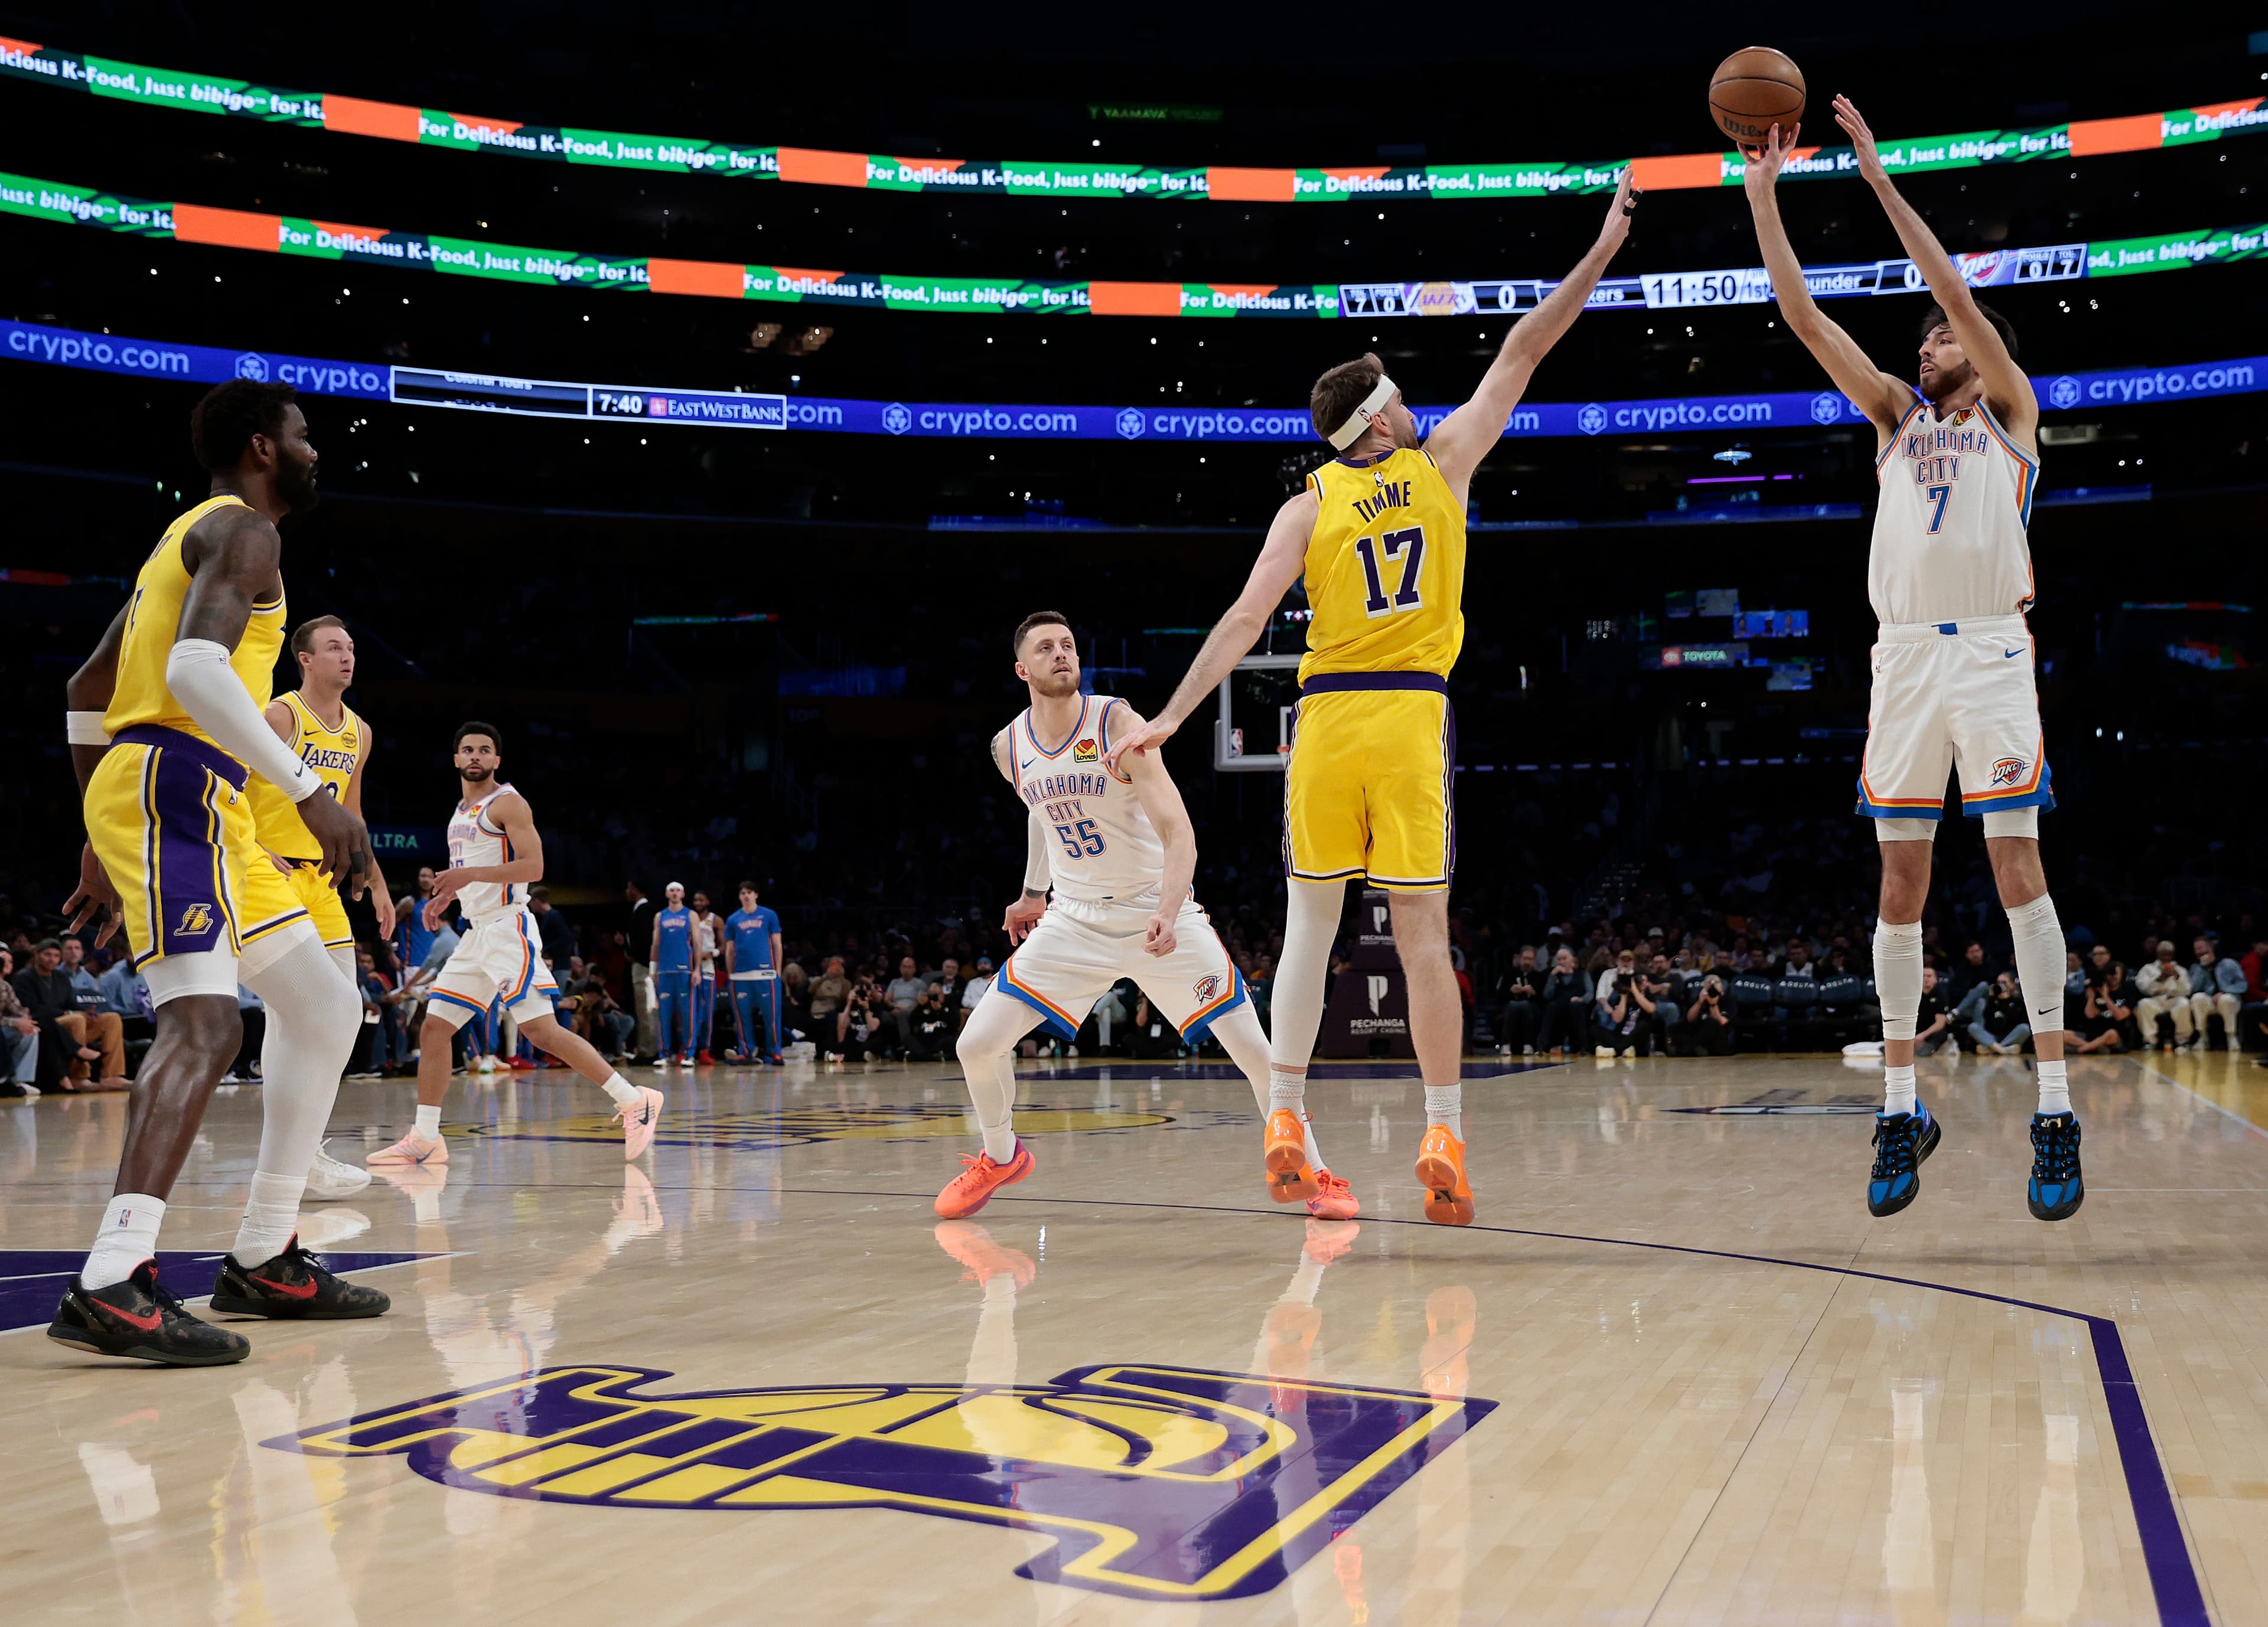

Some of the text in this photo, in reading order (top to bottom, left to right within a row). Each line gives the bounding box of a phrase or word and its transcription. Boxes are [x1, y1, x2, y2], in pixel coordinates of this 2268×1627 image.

[0, 45, 58, 75] icious
[145, 77, 185, 99] Just
[270, 95, 301, 115] for
[1723, 115, 1785, 137] Wils
[2160, 107, 2268, 139] For Deliciou
[418, 116, 449, 137] For
[454, 121, 537, 151] Delicious
[617, 142, 653, 161] Just
[729, 151, 757, 169] for
[1779, 154, 1834, 174] icious
[1837, 149, 1907, 170] K-od,
[1909, 148, 1944, 165] Just
[2020, 135, 2048, 152] for
[865, 162, 895, 181] For
[898, 165, 979, 185] Delicious
[1054, 172, 1089, 188] Just
[1161, 174, 1188, 190] for
[1292, 176, 1322, 194] For
[1325, 174, 1404, 193] Delicious
[1477, 173, 1512, 190] Just
[1584, 169, 1611, 185] for
[119, 204, 149, 224] for
[278, 224, 311, 245] For
[316, 230, 403, 257] Delicious
[484, 252, 520, 271] Just
[598, 263, 627, 281] for
[2119, 249, 2154, 266] Just
[2231, 233, 2259, 251] for
[1807, 272, 1863, 292] under
[1904, 263, 1922, 289] 0
[2029, 261, 2043, 279] 0
[2060, 260, 2074, 277] 7
[742, 273, 773, 291] For
[777, 275, 858, 297] Delicious
[933, 287, 968, 304] Just
[1042, 289, 1069, 305] for
[1179, 291, 1339, 309] For Delicious K-Fo
[1498, 284, 1517, 311] 0
[1588, 288, 1625, 302] kers
[1653, 275, 1737, 304] 11:50
[1354, 296, 1367, 313] 7
[1383, 296, 1396, 312] 0
[9, 331, 188, 373] crypto.com
[278, 364, 389, 392] crypto.
[2089, 366, 2253, 401] crypto.com
[598, 393, 643, 414] 7:40
[1615, 403, 1771, 429] crypto.com
[920, 409, 1076, 434] crypto.com
[1154, 413, 1308, 437] crypto.com
[1916, 455, 1961, 485] CITY
[1352, 481, 1411, 523] TIMME
[1927, 482, 1953, 535] 7
[1354, 524, 1427, 620] 17
[1683, 650, 1727, 662] TOYOTA
[301, 742, 356, 774] LAKERS
[1021, 773, 1107, 807] OKLAHOMA
[1045, 799, 1086, 823] CITY
[1052, 817, 1107, 860] 55
[1350, 1018, 1406, 1028] PECHANGA
